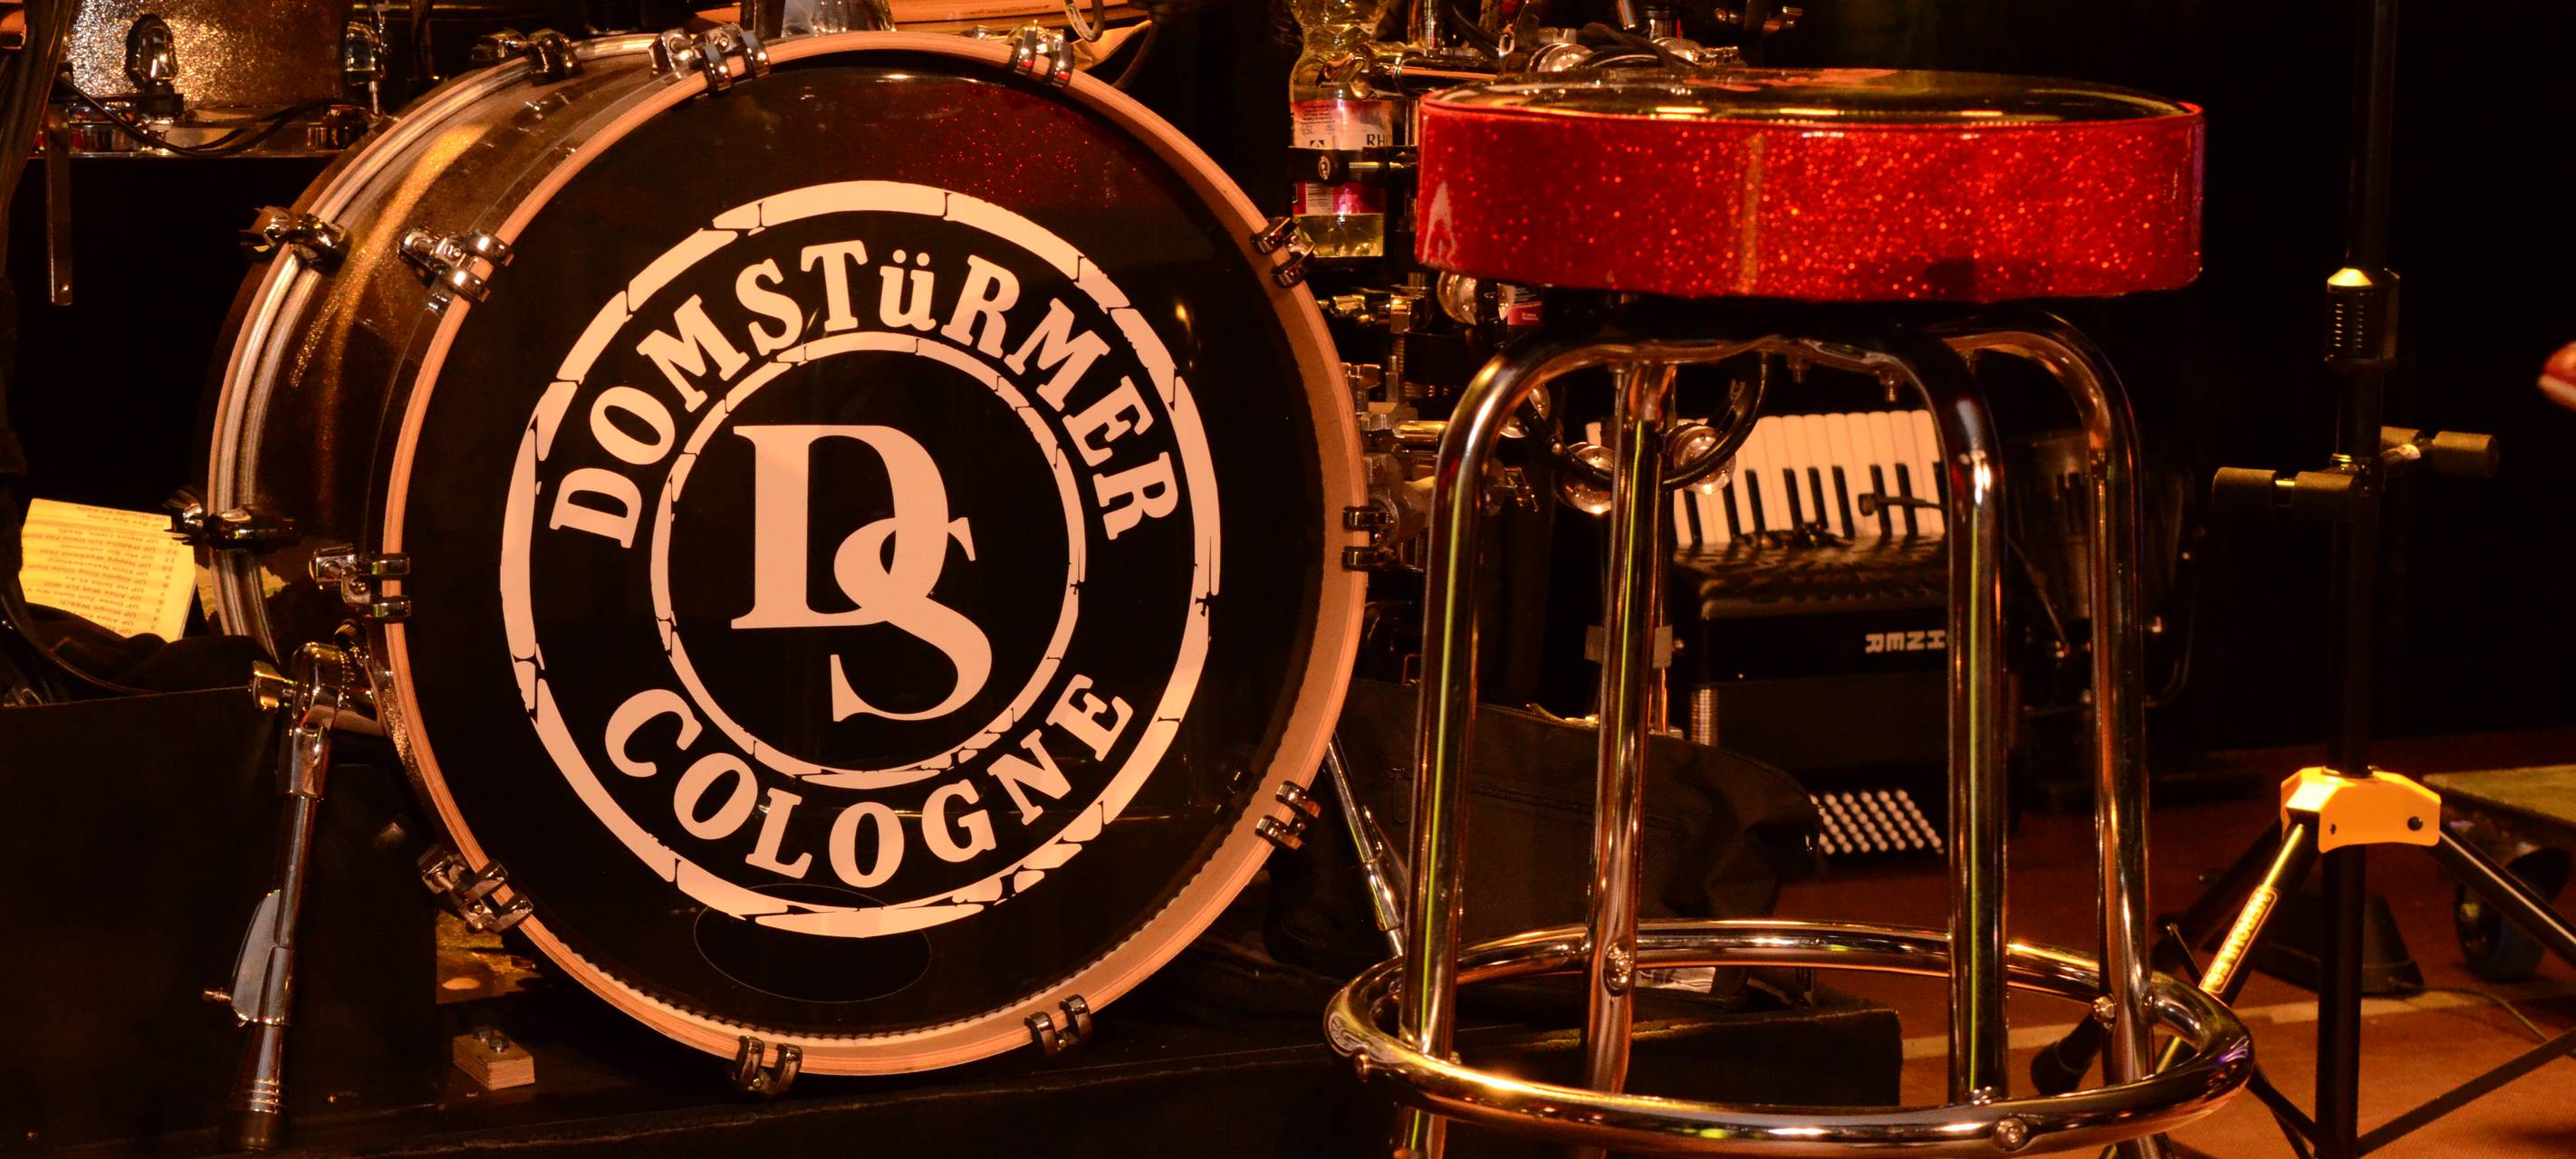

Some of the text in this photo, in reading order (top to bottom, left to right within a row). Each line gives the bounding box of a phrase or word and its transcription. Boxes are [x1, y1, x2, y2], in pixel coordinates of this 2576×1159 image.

[732, 426, 991, 722] DS
[1865, 629, 1946, 653] HNER
[606, 675, 1133, 888] COLOGNE
